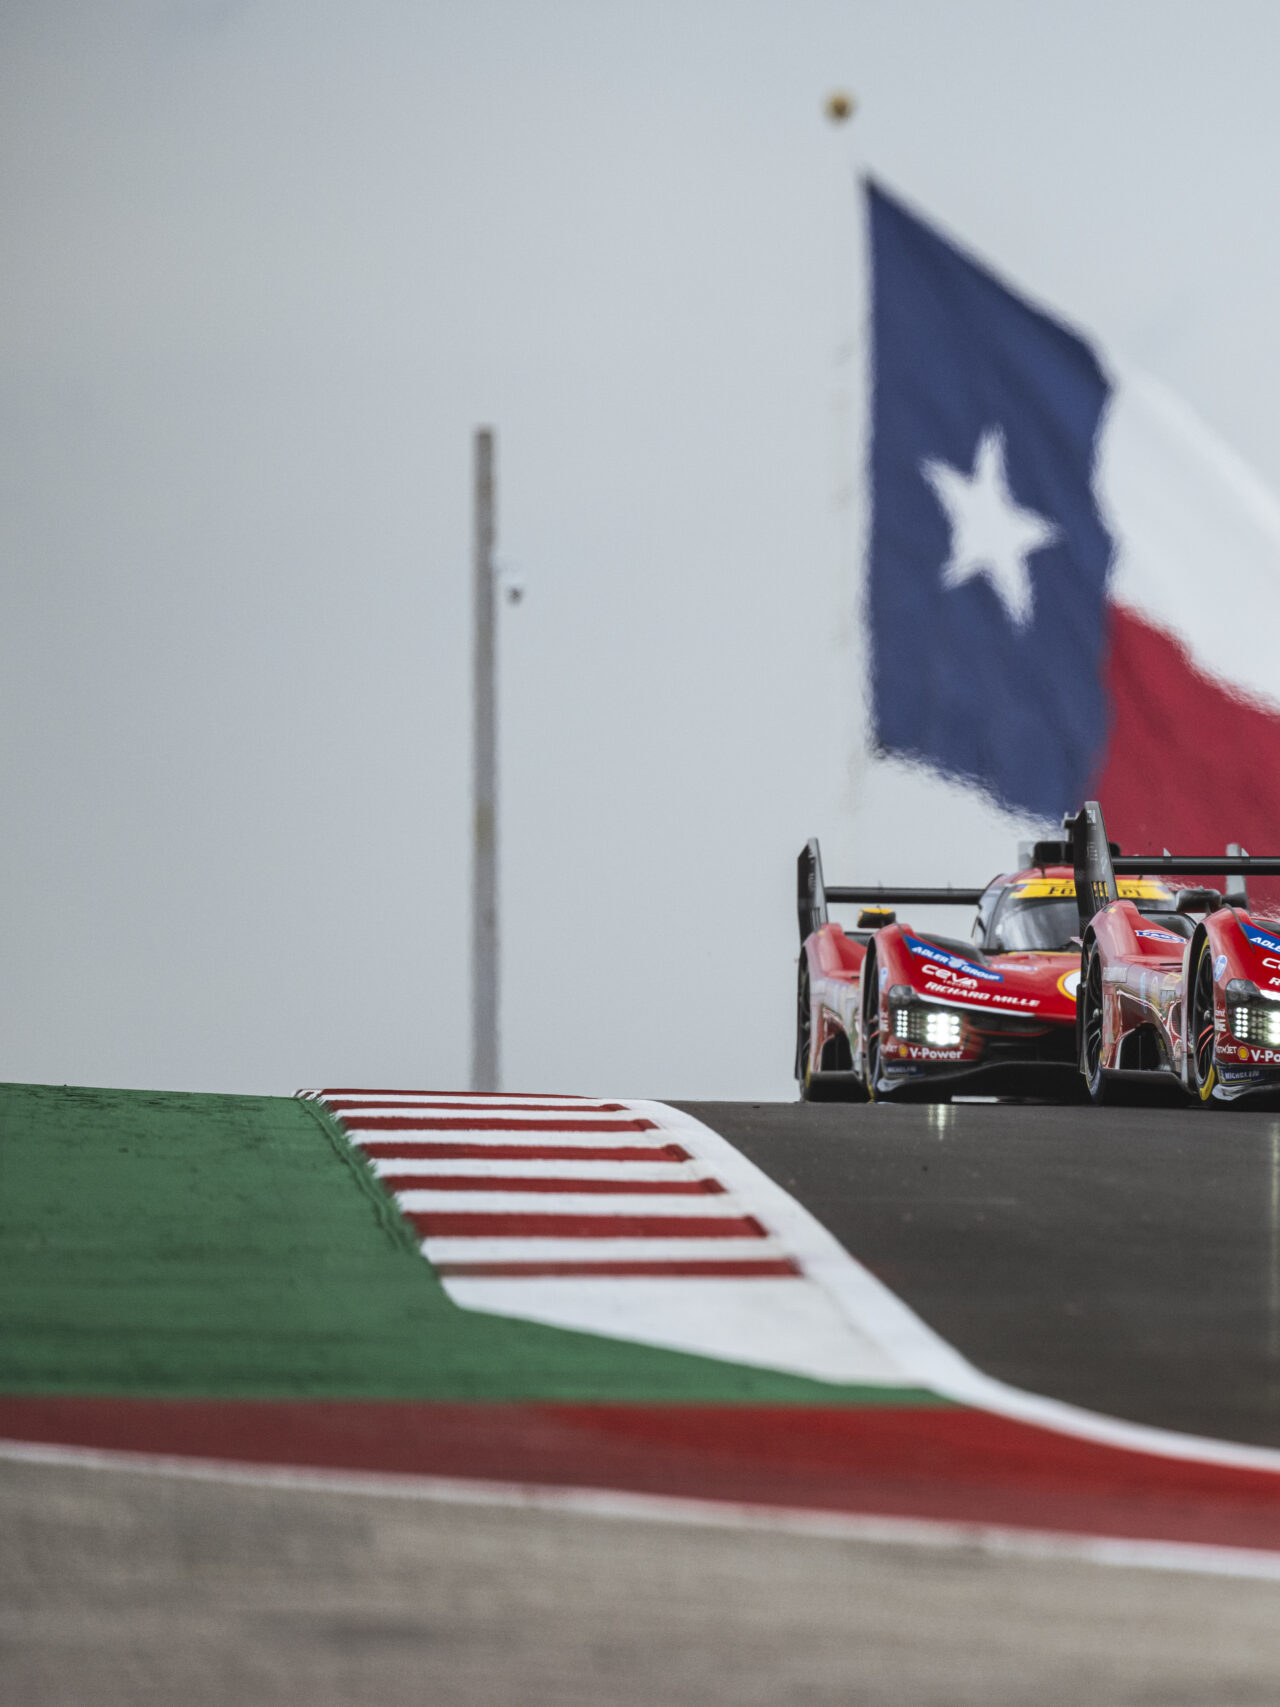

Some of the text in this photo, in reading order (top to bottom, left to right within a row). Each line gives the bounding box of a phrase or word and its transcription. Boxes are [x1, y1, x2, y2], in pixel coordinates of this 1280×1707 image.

[911, 946, 1001, 981] ADLER GROUP
[924, 981, 1041, 1008] RICHARD MILLE
[910, 1046, 963, 1060] V-Power
[1224, 1070, 1260, 1080] MICHELIN
